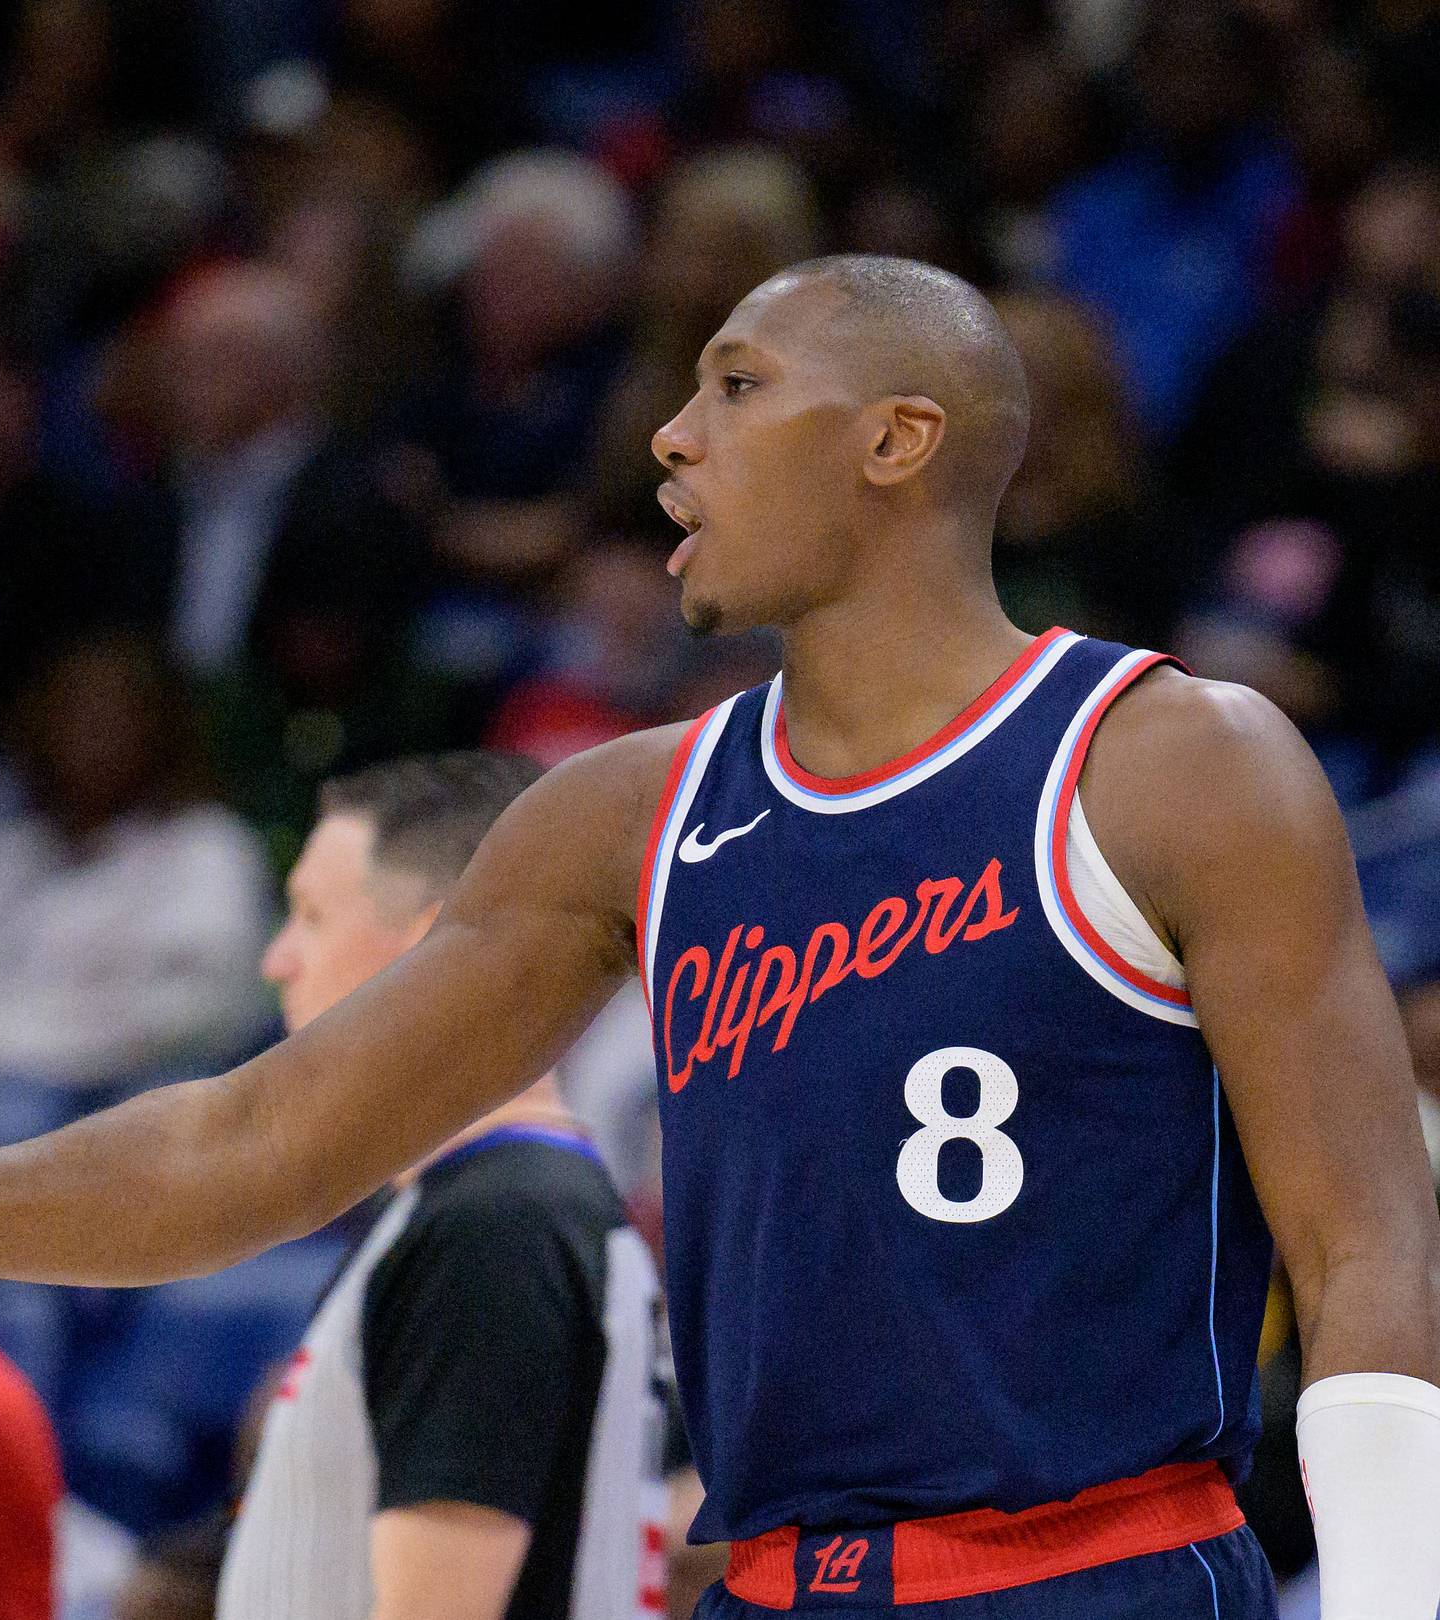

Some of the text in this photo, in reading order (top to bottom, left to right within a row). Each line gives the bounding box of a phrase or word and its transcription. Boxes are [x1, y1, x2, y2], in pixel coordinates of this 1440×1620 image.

[664, 857, 1020, 1093] Clippers
[896, 1046, 1024, 1223] 8
[808, 1535, 870, 1593] LA
